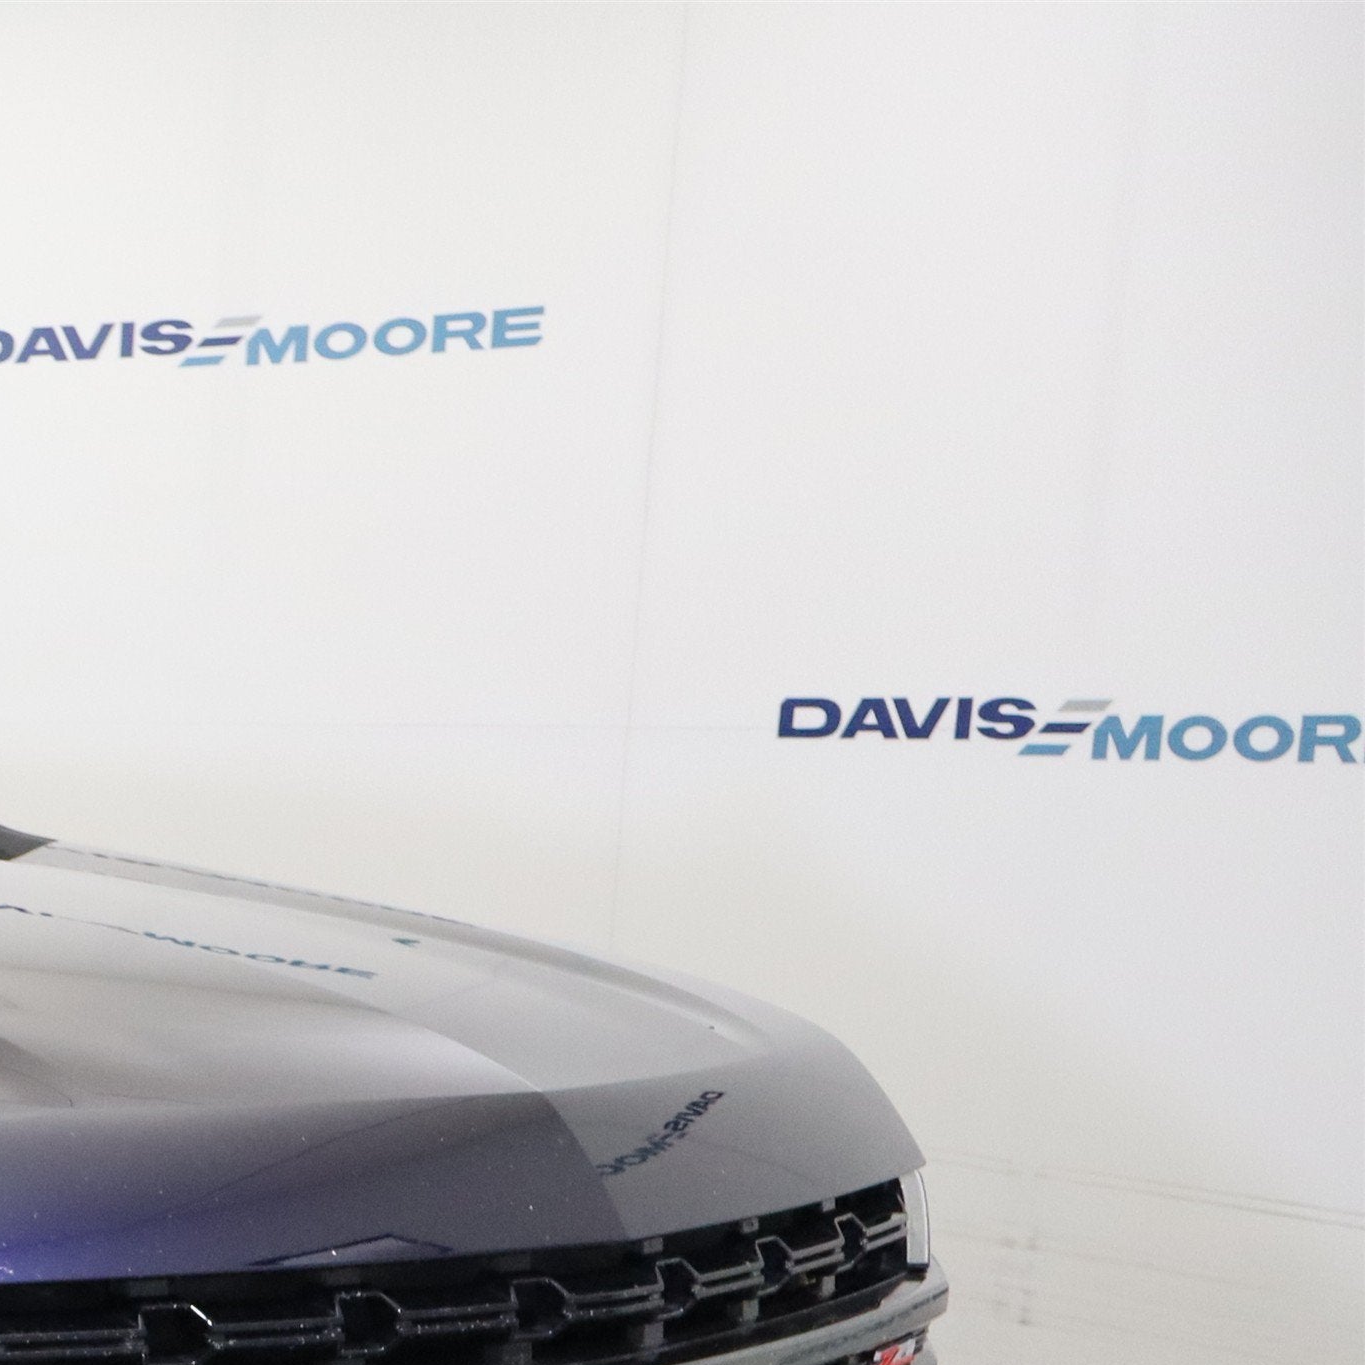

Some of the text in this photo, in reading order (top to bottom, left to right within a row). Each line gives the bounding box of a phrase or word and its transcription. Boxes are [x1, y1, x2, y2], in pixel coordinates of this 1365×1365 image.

[245, 305, 545, 366] MOORE
[777, 696, 1365, 764] DAVIS MOOR
